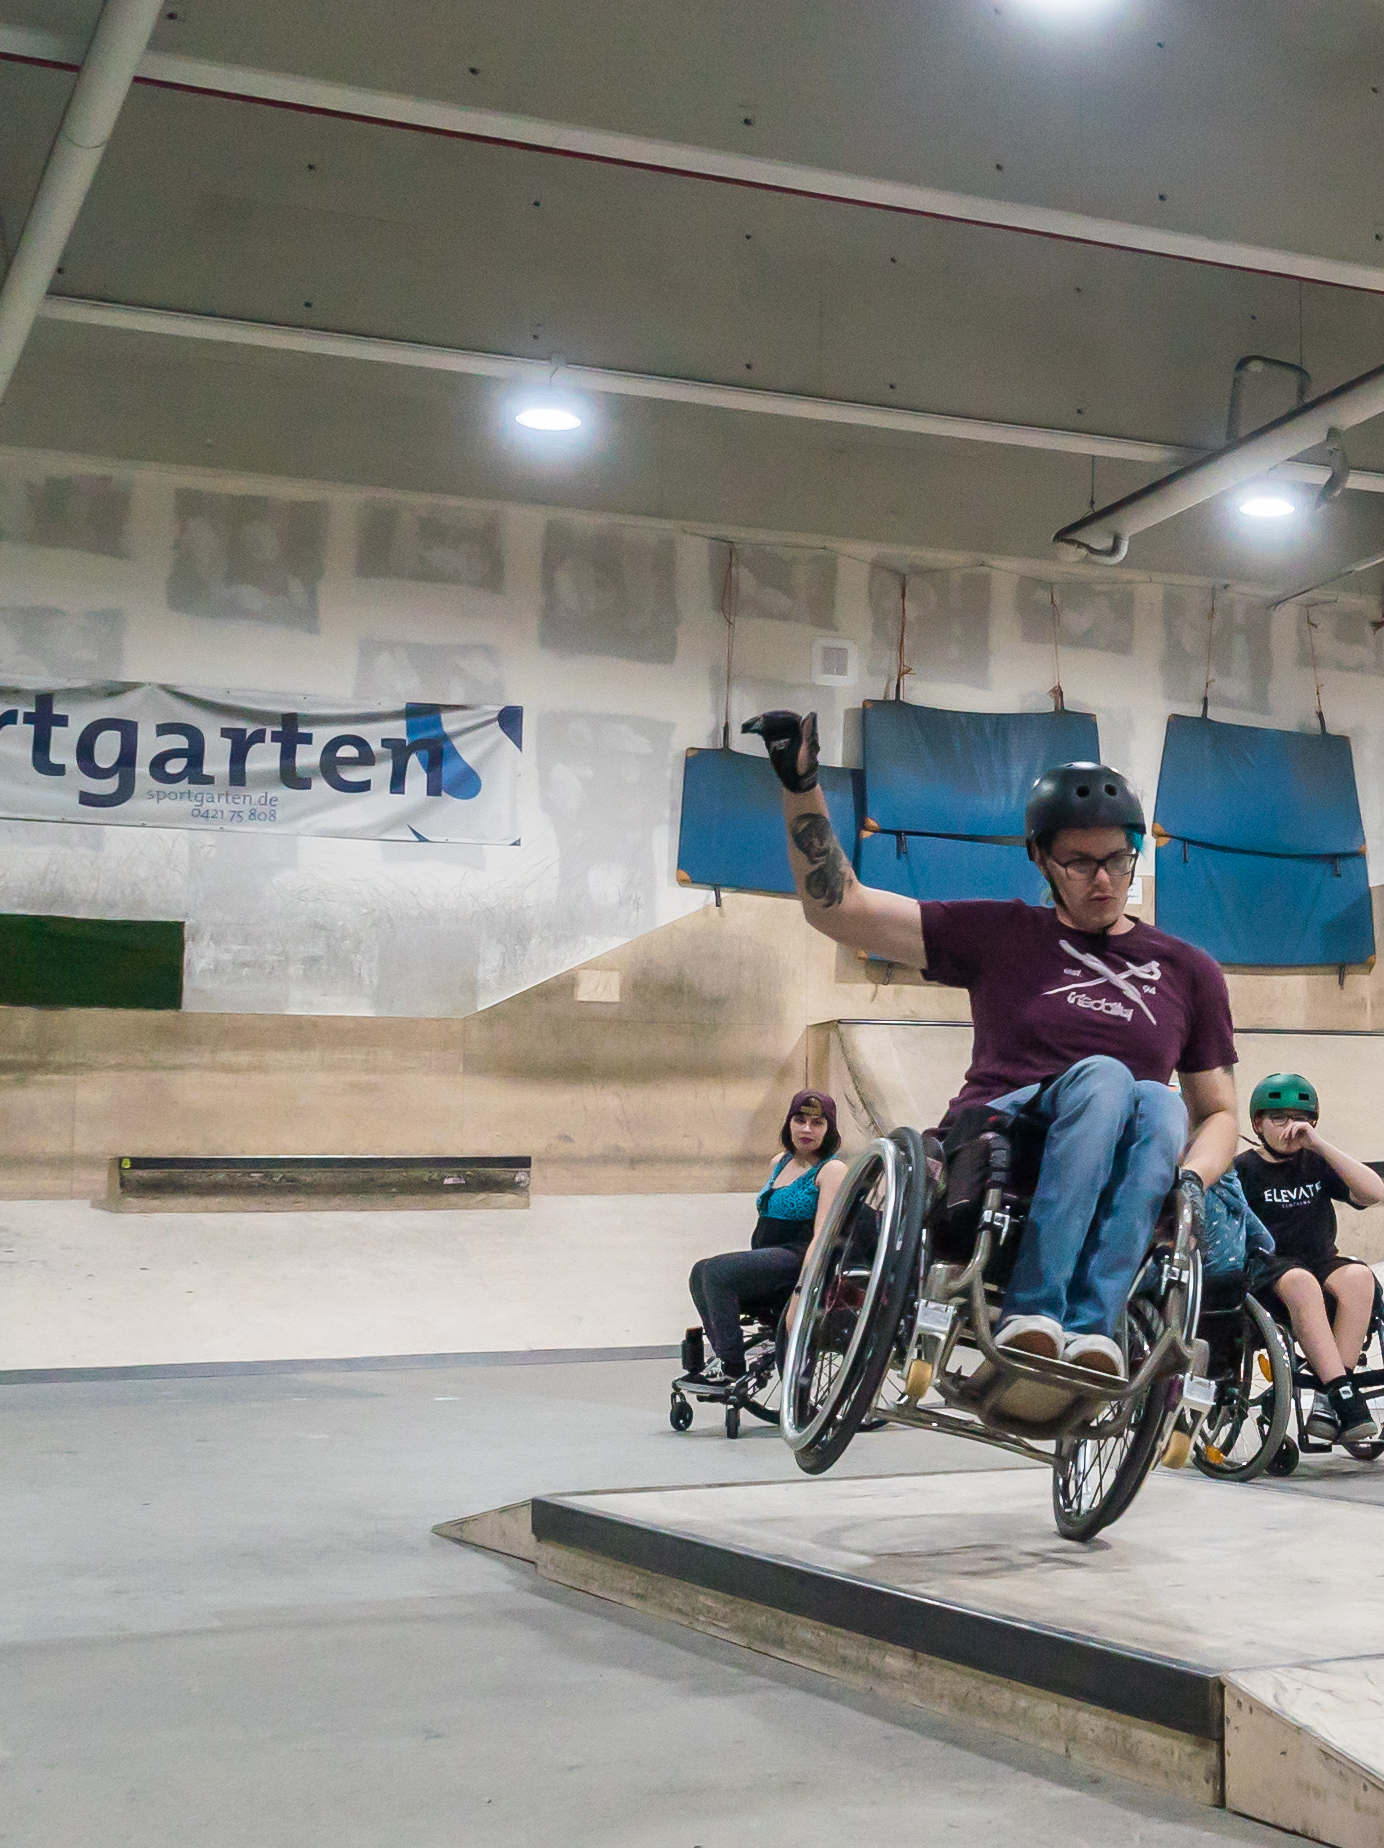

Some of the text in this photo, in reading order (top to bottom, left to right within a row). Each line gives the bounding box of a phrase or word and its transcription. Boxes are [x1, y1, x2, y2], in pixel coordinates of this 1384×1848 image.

[147, 789, 279, 807] sportgarten.de
[191, 808, 277, 823] 0421 75 808
[1263, 1180, 1322, 1203] ELEVATE
